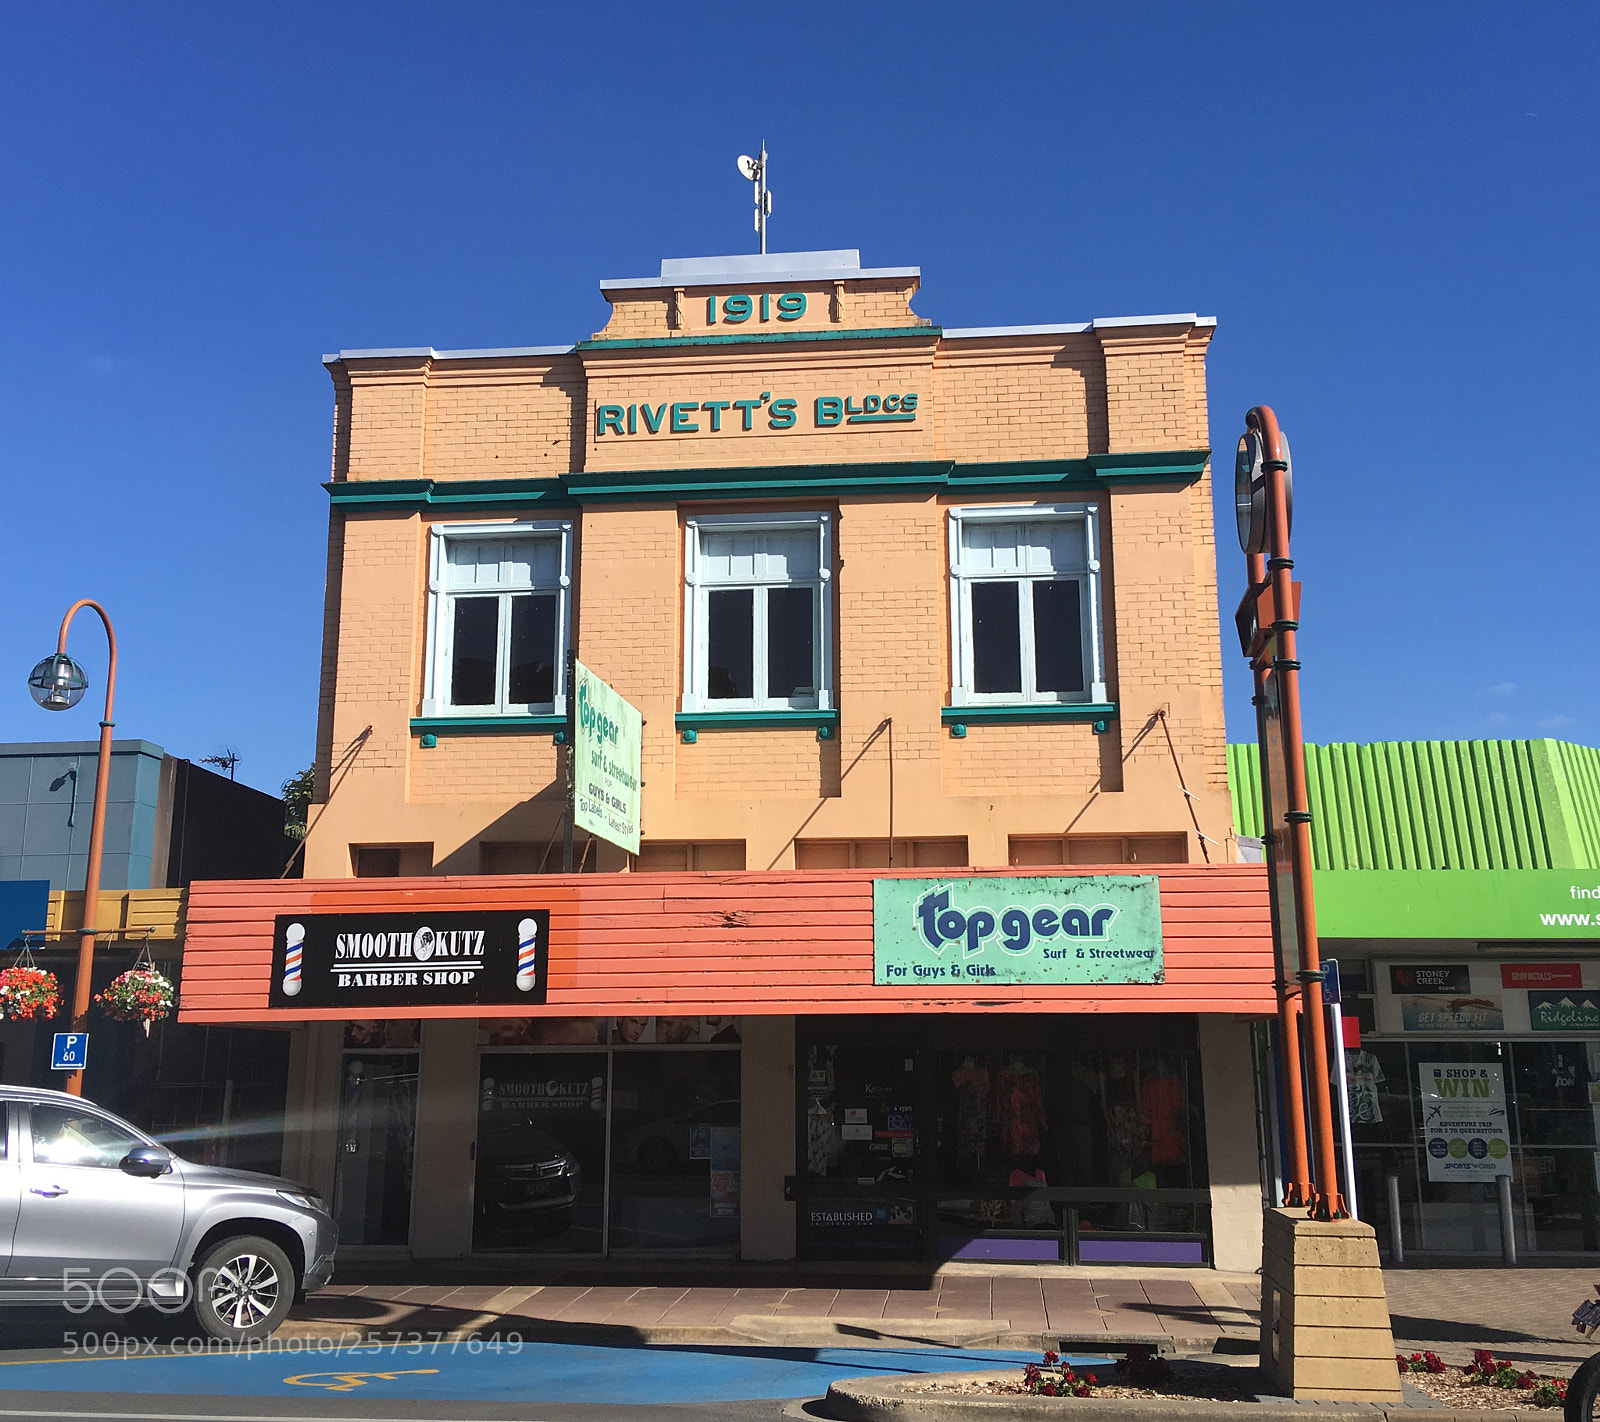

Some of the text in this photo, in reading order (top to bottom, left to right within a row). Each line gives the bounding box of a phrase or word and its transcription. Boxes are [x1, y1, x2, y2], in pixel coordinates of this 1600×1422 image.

[706, 292, 808, 323] 1919
[597, 391, 797, 437] RIVETT'S
[589, 783, 627, 814] GUYS & GIRLS
[580, 798, 588, 814] Top
[589, 799, 602, 818] Labels
[335, 930, 485, 959] SMOOTH KUTZ
[1043, 948, 1156, 959] Surf & Streetwear
[886, 964, 996, 979] For Guys & Girls
[1415, 970, 1450, 978] STONEY
[337, 971, 475, 987] BARBER SHOP
[1416, 977, 1445, 985] CREEK
[1418, 1012, 1489, 1023] GET SPEEDO FIT
[1540, 1010, 1599, 1026] Ridgeline
[67, 1036, 78, 1049] P
[63, 1051, 76, 1062] 60
[1446, 1069, 1488, 1078] SHOP &
[498, 1082, 589, 1096] SMOOTH KUTZ
[1434, 1078, 1490, 1098] WIN
[551, 1101, 584, 1109] SHOP
[810, 1212, 873, 1222] ESTABLISHED
